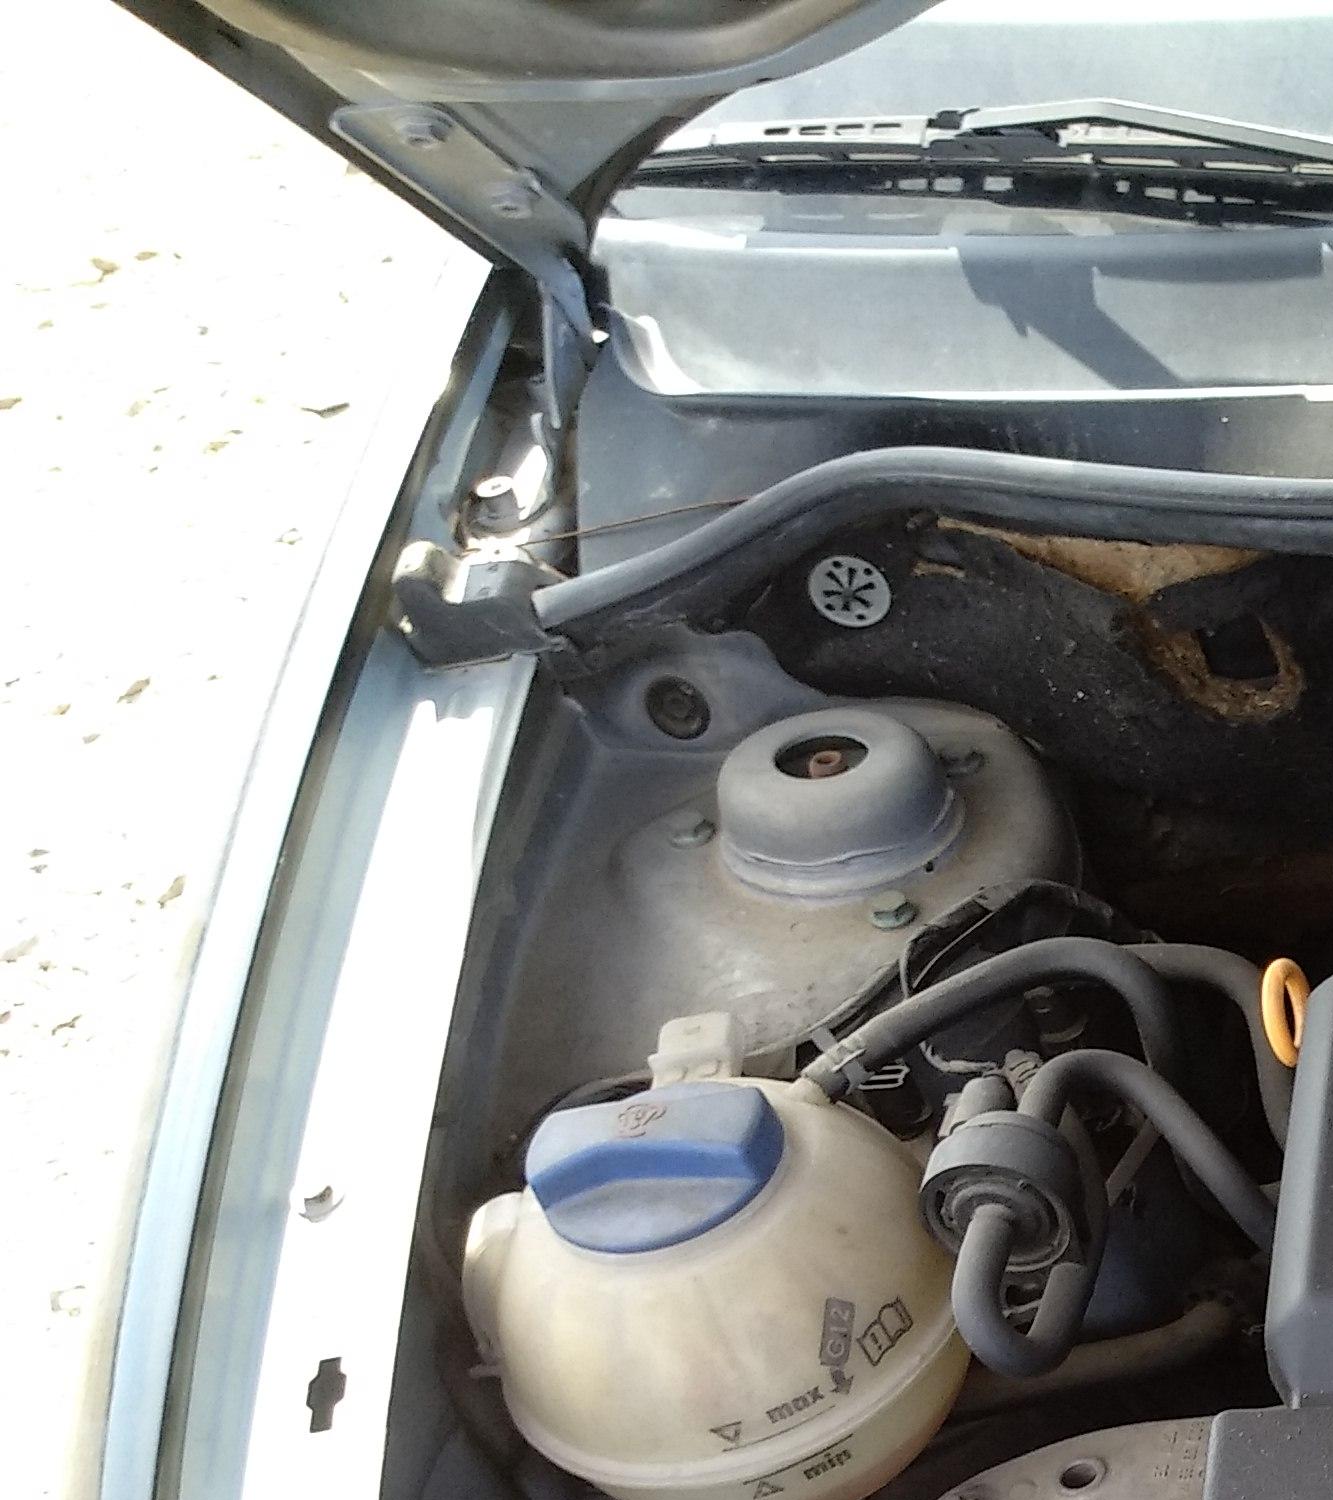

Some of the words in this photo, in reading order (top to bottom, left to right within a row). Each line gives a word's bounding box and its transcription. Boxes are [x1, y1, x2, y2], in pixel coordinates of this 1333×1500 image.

[826, 1306, 849, 1358] G12
[765, 1386, 825, 1424] max
[803, 1449, 851, 1480] min
